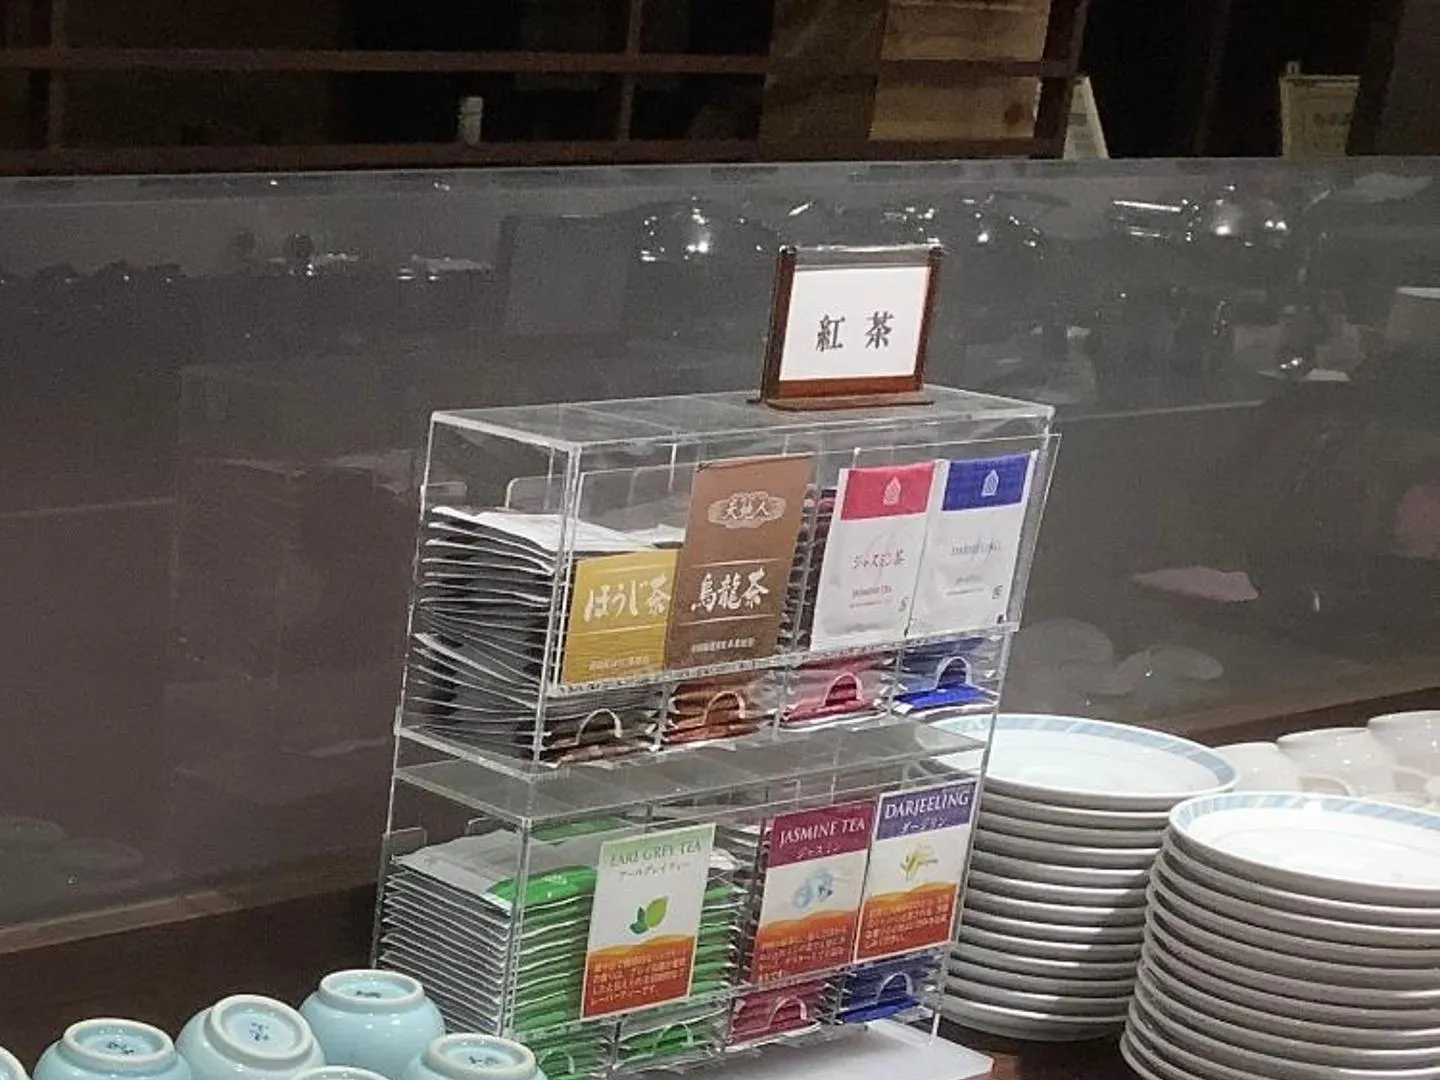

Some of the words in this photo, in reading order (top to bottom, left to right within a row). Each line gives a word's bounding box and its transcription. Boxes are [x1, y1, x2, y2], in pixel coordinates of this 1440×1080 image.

[815, 310, 895, 352] 紅茶
[583, 575, 671, 623] ほうじ茶
[884, 789, 971, 819] DARJEELING
[779, 820, 838, 849] JASMINE
[841, 817, 866, 833] TEA
[610, 849, 638, 867] EARL
[642, 844, 674, 861] GREY
[679, 838, 702, 855] TEA
